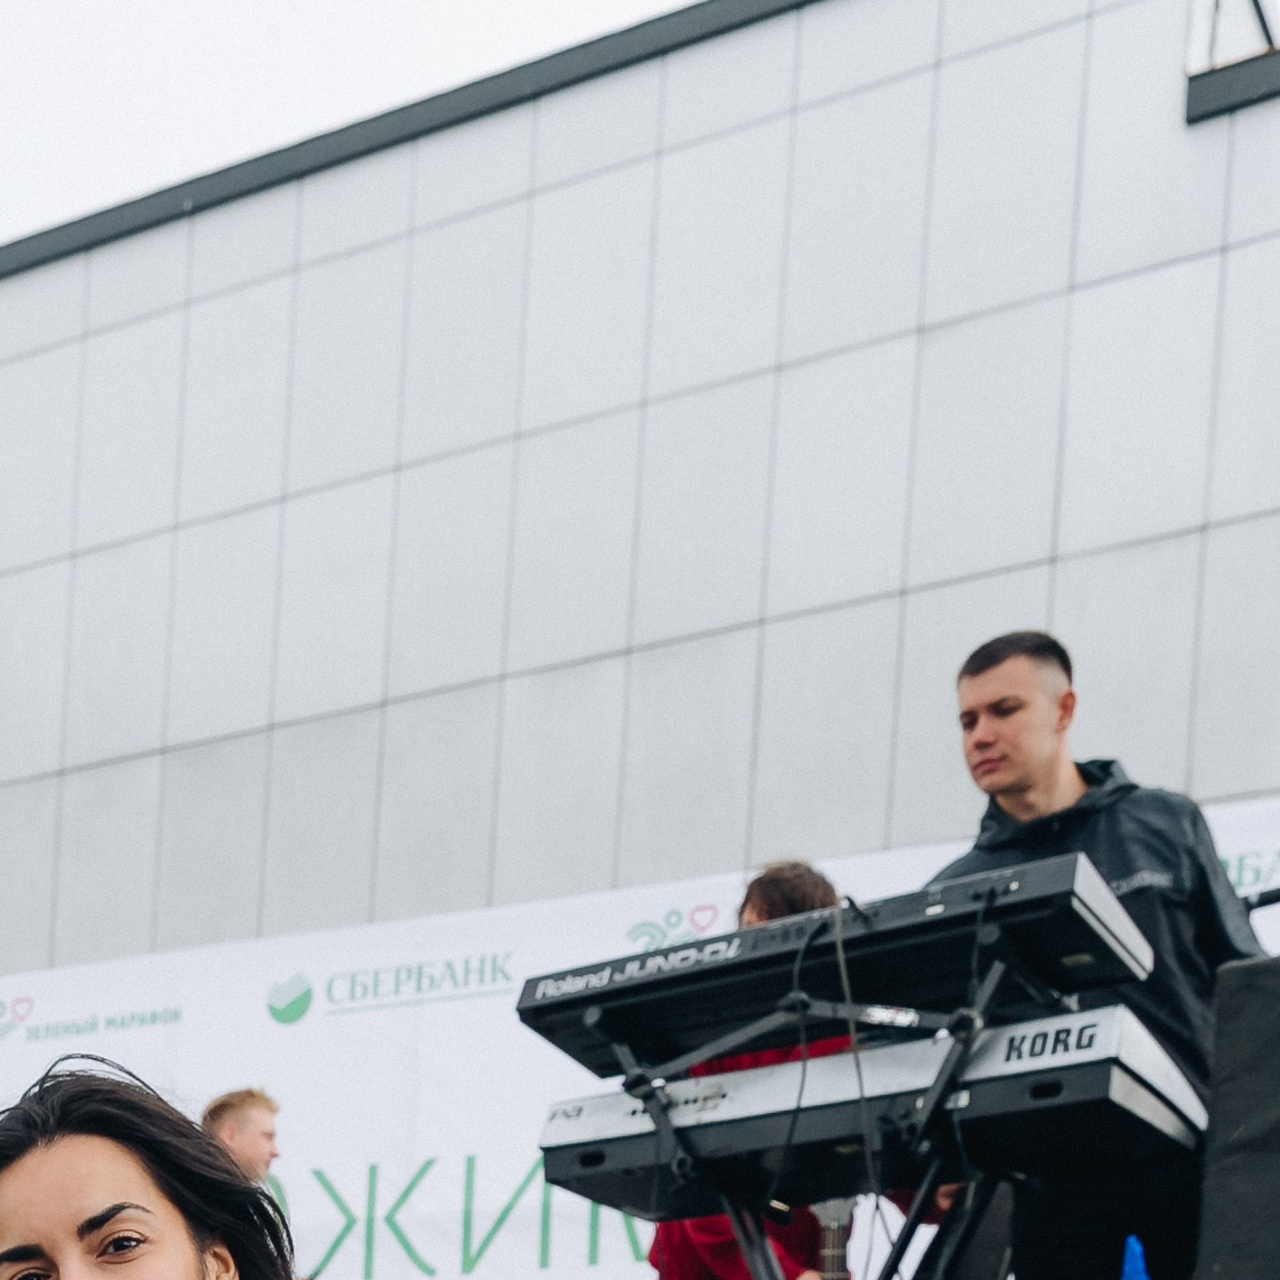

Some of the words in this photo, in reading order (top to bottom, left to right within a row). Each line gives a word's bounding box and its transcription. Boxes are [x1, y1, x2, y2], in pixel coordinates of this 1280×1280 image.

[325, 950, 516, 1005] СБЕРБАНК
[533, 966, 612, 1001] Roland
[1004, 1023, 1098, 1063] KORG
